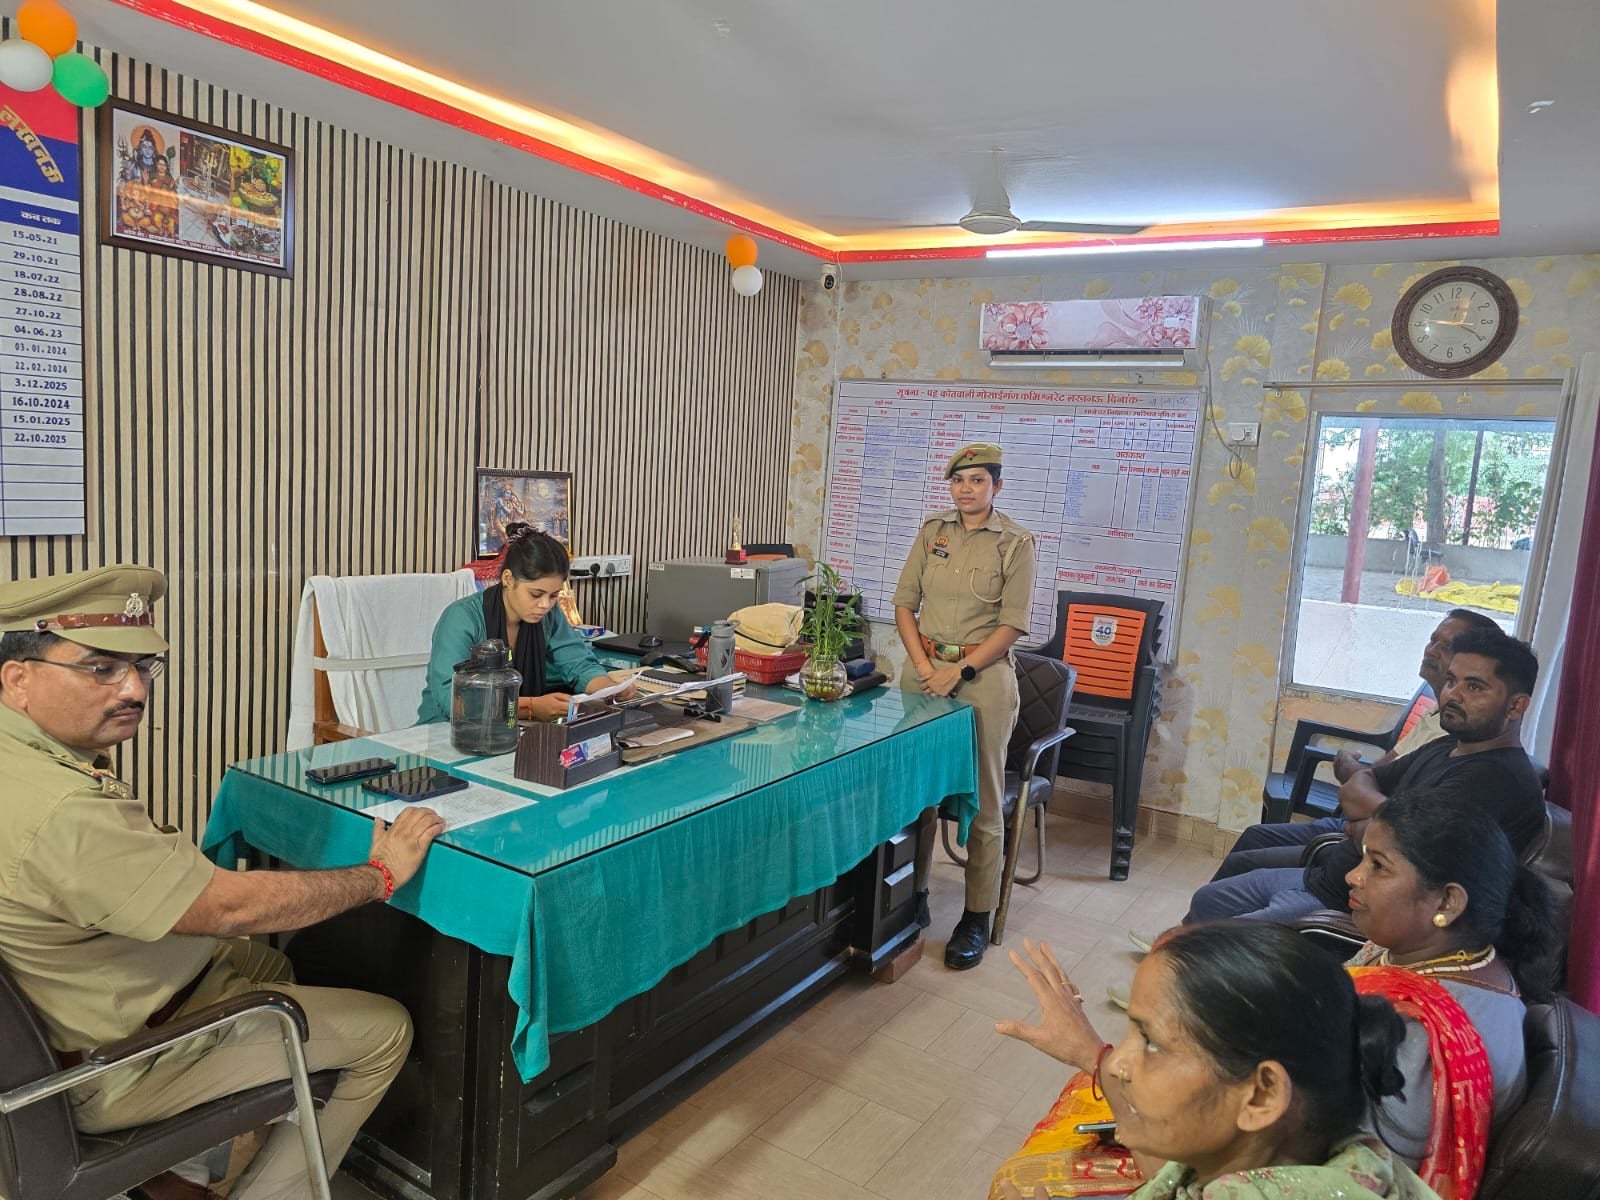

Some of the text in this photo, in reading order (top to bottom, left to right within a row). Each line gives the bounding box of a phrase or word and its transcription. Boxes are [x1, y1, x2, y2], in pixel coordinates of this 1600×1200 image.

[12, 230, 57, 245] 15.05.21
[13, 251, 59, 265] 29.10.21
[14, 270, 60, 284] 18.07.22
[14, 287, 62, 302] 28.08.22
[1433, 292, 1445, 304] 11
[1451, 287, 1462, 299] 12
[1420, 303, 1433, 314] 10
[1477, 302, 1490, 311] 2
[16, 307, 61, 320] 27.10.22
[14, 325, 62, 338] 04.06.23
[1416, 334, 1429, 343] 8
[15, 342, 67, 355] 03.01.2024
[1429, 343, 1439, 354] 7
[1446, 347, 1453, 358] 6
[1463, 343, 1471, 354] 5
[15, 361, 68, 374] 22.02.2024
[15, 378, 68, 391] 3.12.2025
[896, 388, 919, 399] सूचना
[940, 388, 975, 399] कोतवाली
[1067, 394, 1104, 404] लखनऊ
[12, 396, 70, 409] 16.10.2024
[13, 414, 71, 426] 15.01.2025
[14, 432, 67, 444] 22.10.2025
[1096, 626, 1112, 635] 40
